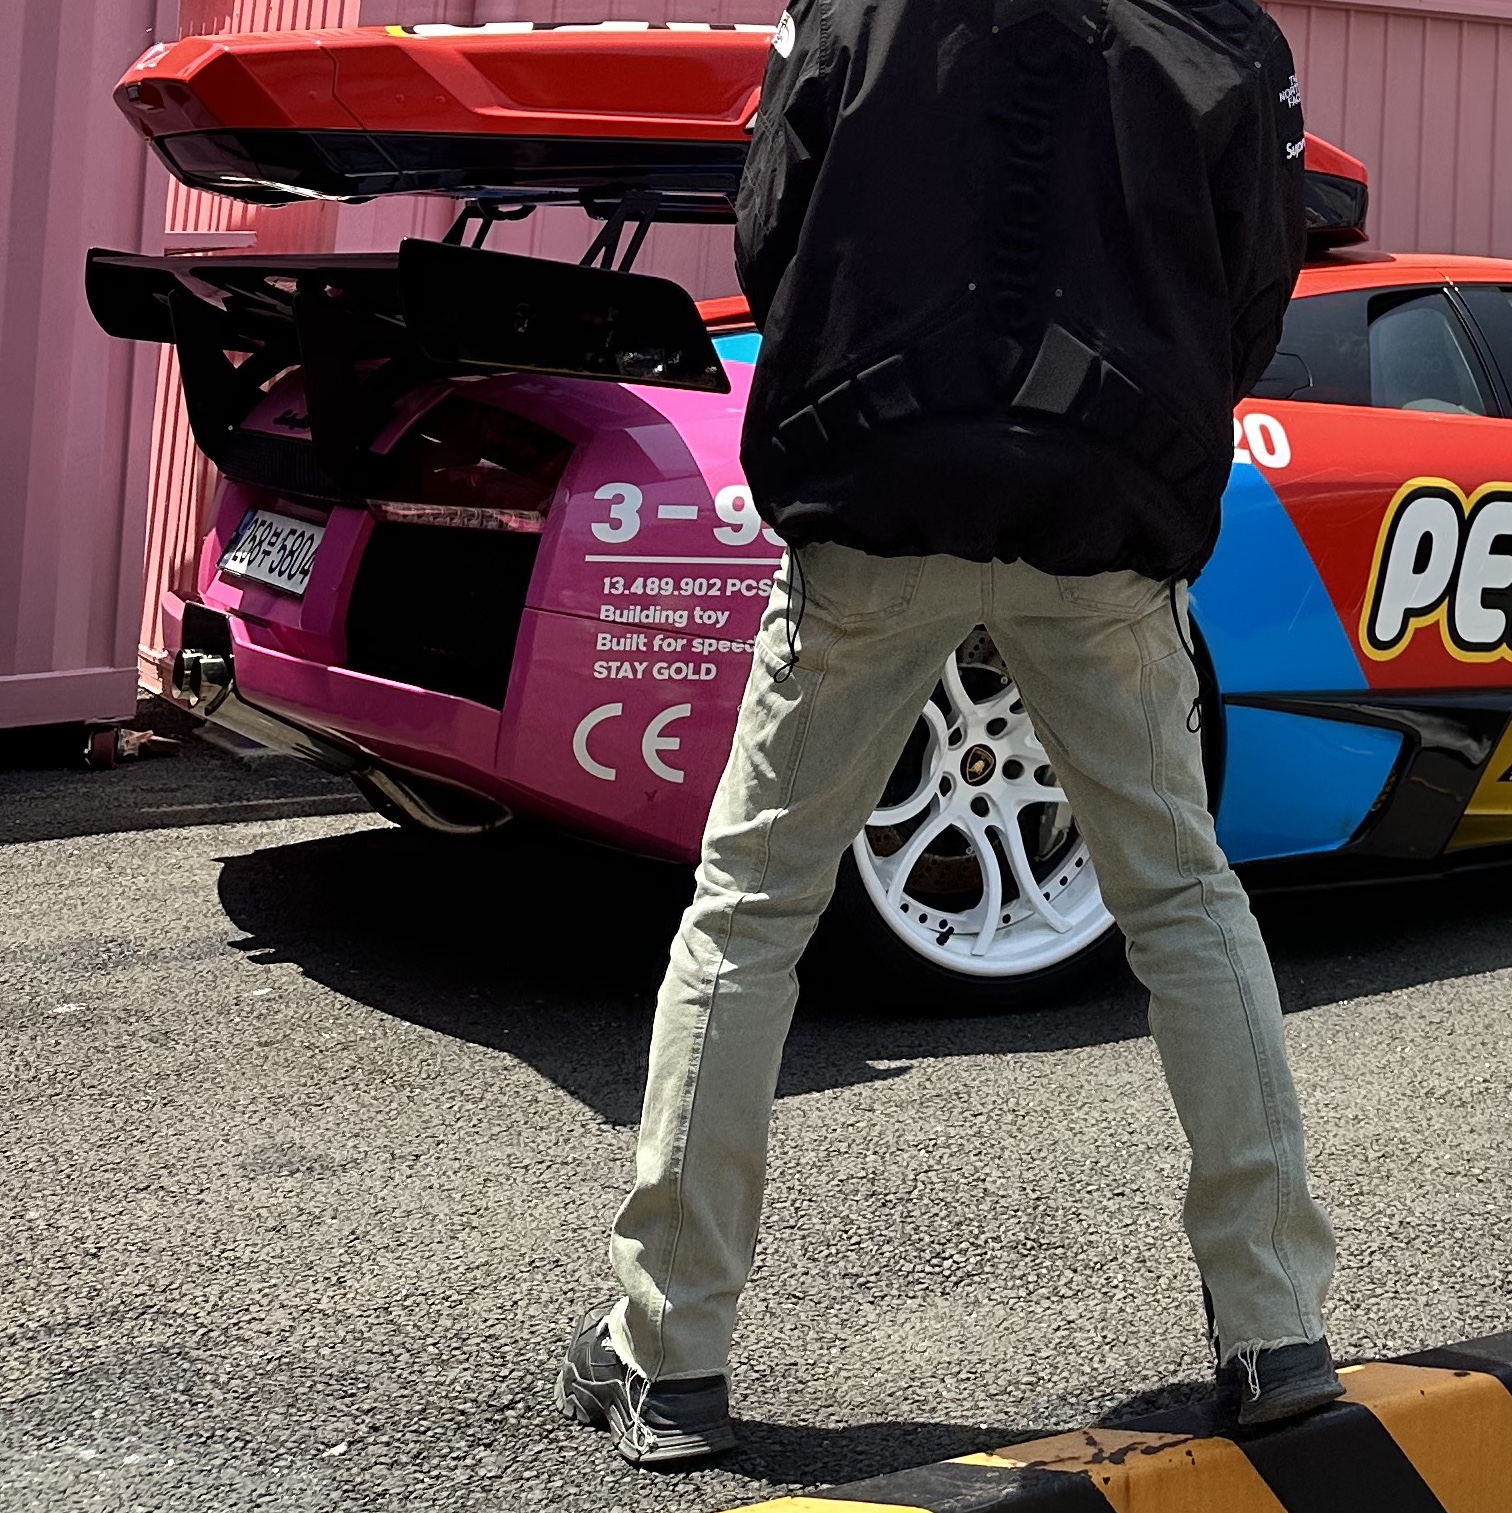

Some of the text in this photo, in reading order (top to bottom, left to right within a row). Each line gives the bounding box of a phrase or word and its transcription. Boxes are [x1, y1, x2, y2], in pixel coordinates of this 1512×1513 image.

[603, 576, 772, 597] 13.489.902 PCS
[600, 605, 730, 629] Building toy
[596, 633, 648, 652] Built
[653, 634, 688, 652] for
[593, 661, 717, 680] STAY GOLD
